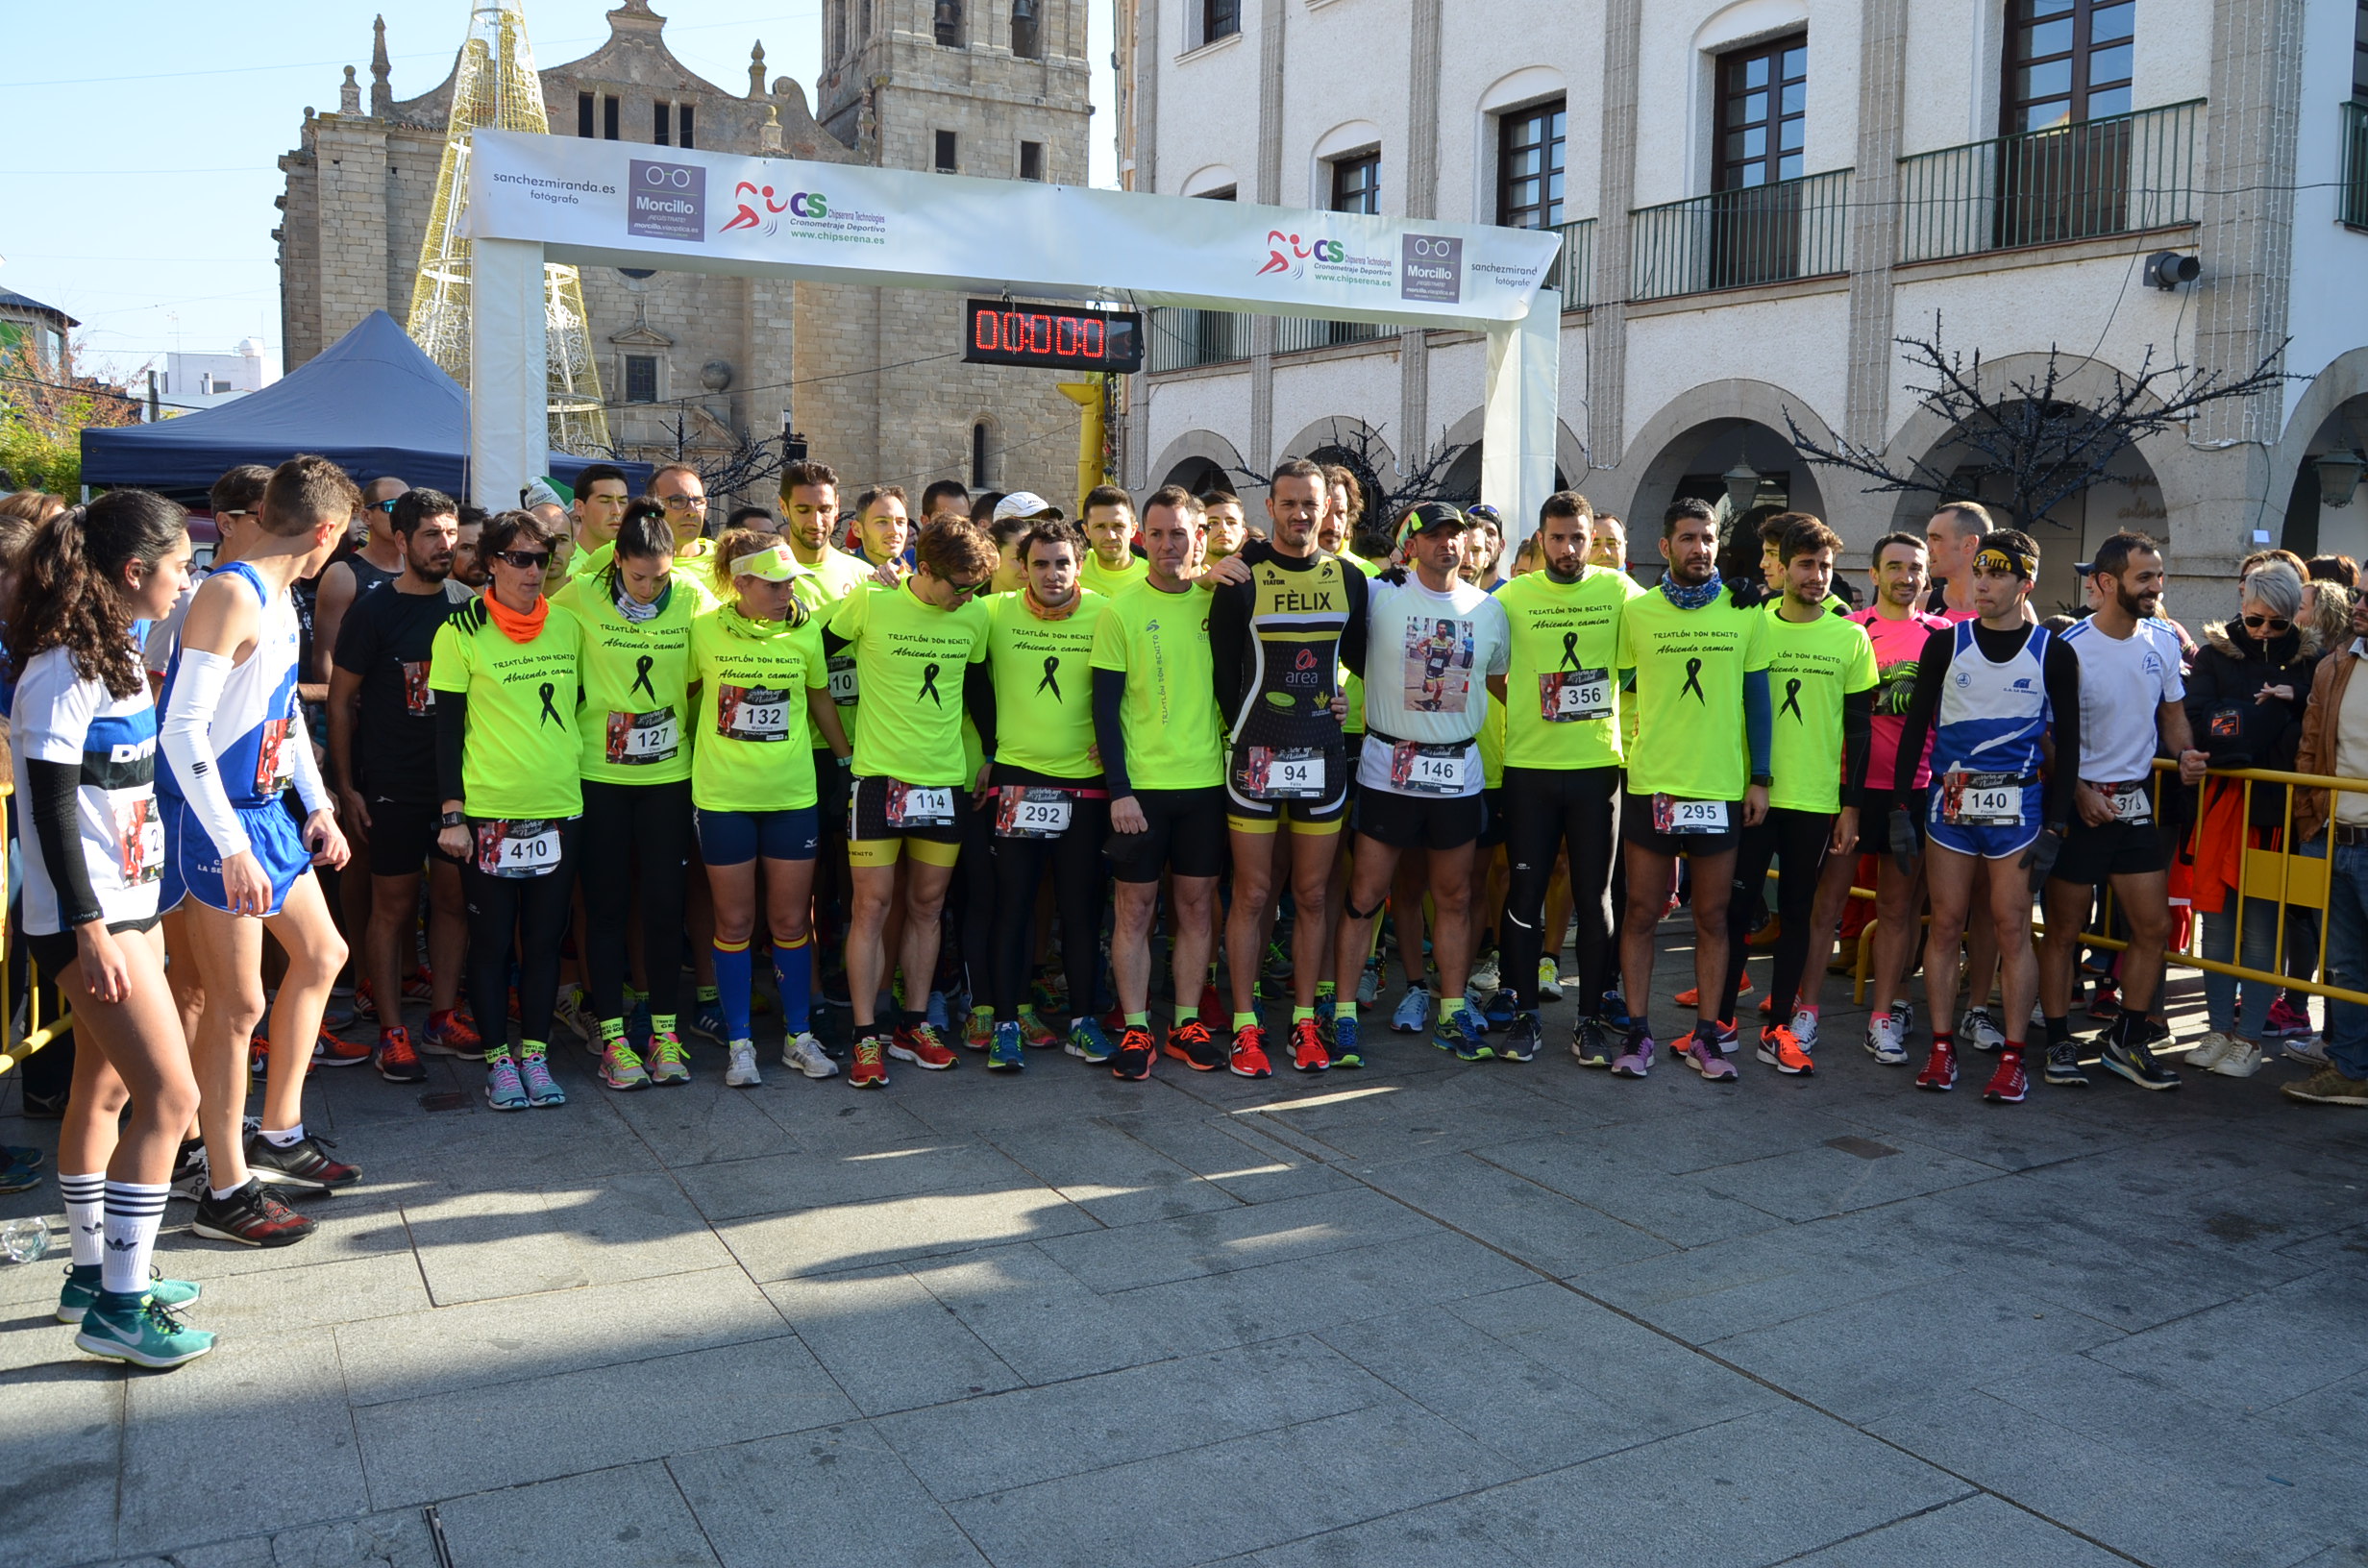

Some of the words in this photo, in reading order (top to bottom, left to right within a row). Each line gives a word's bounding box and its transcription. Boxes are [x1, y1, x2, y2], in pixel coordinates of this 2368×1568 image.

[493, 172, 616, 194] sanchezmiranda.es
[530, 190, 579, 205] fotógrafo
[790, 192, 827, 219] CS
[828, 208, 854, 221] Chipserena
[855, 211, 885, 225] Technologies
[790, 218, 845, 231] Cronometraje
[847, 223, 886, 233] Deportivo
[790, 231, 884, 245] www.chipserena.es
[1313, 239, 1344, 263] CS
[1314, 263, 1359, 274] Cronometraje
[1360, 267, 1392, 277] Deportivo
[1471, 262, 1538, 276] sanchezmirand
[1315, 274, 1392, 286] www.chipserena.es
[1274, 590, 1332, 612] FÈLIX
[1528, 605, 1565, 615] TRIATLÓN
[600, 624, 640, 634] TRIATLÓN
[1531, 621, 1574, 630] Abriendo
[888, 634, 928, 643] TRIATLÓN
[1011, 628, 1048, 638] TRIATLÓN
[1653, 629, 1690, 639] TRIATLÓN
[602, 637, 650, 649] Abriendo
[1013, 641, 1056, 651] Abriendo
[1061, 644, 1092, 653] camin
[1153, 634, 1163, 665] BENITO
[1655, 644, 1698, 655] Abriendo
[715, 653, 753, 663] TRIATLÓN
[891, 648, 936, 658] Abriendo
[1813, 653, 1840, 664] BENITO
[492, 655, 533, 669] TRIATLÓN
[503, 667, 548, 684] Abriendo
[718, 669, 763, 679] Abriendo
[1286, 672, 1319, 684] area
[1803, 667, 1835, 676] camino
[1568, 688, 1601, 705] 356
[1157, 686, 1169, 724] TRIATLÓN
[746, 709, 780, 724] 132
[638, 727, 669, 747] 127
[1284, 765, 1307, 780] 94
[1422, 761, 1453, 778] 146
[917, 793, 946, 809] 114
[1972, 793, 2007, 809] 140
[1024, 805, 1060, 824] 292
[1682, 805, 1716, 820] 295
[511, 840, 547, 859] 410
[198, 864, 208, 872] LA
